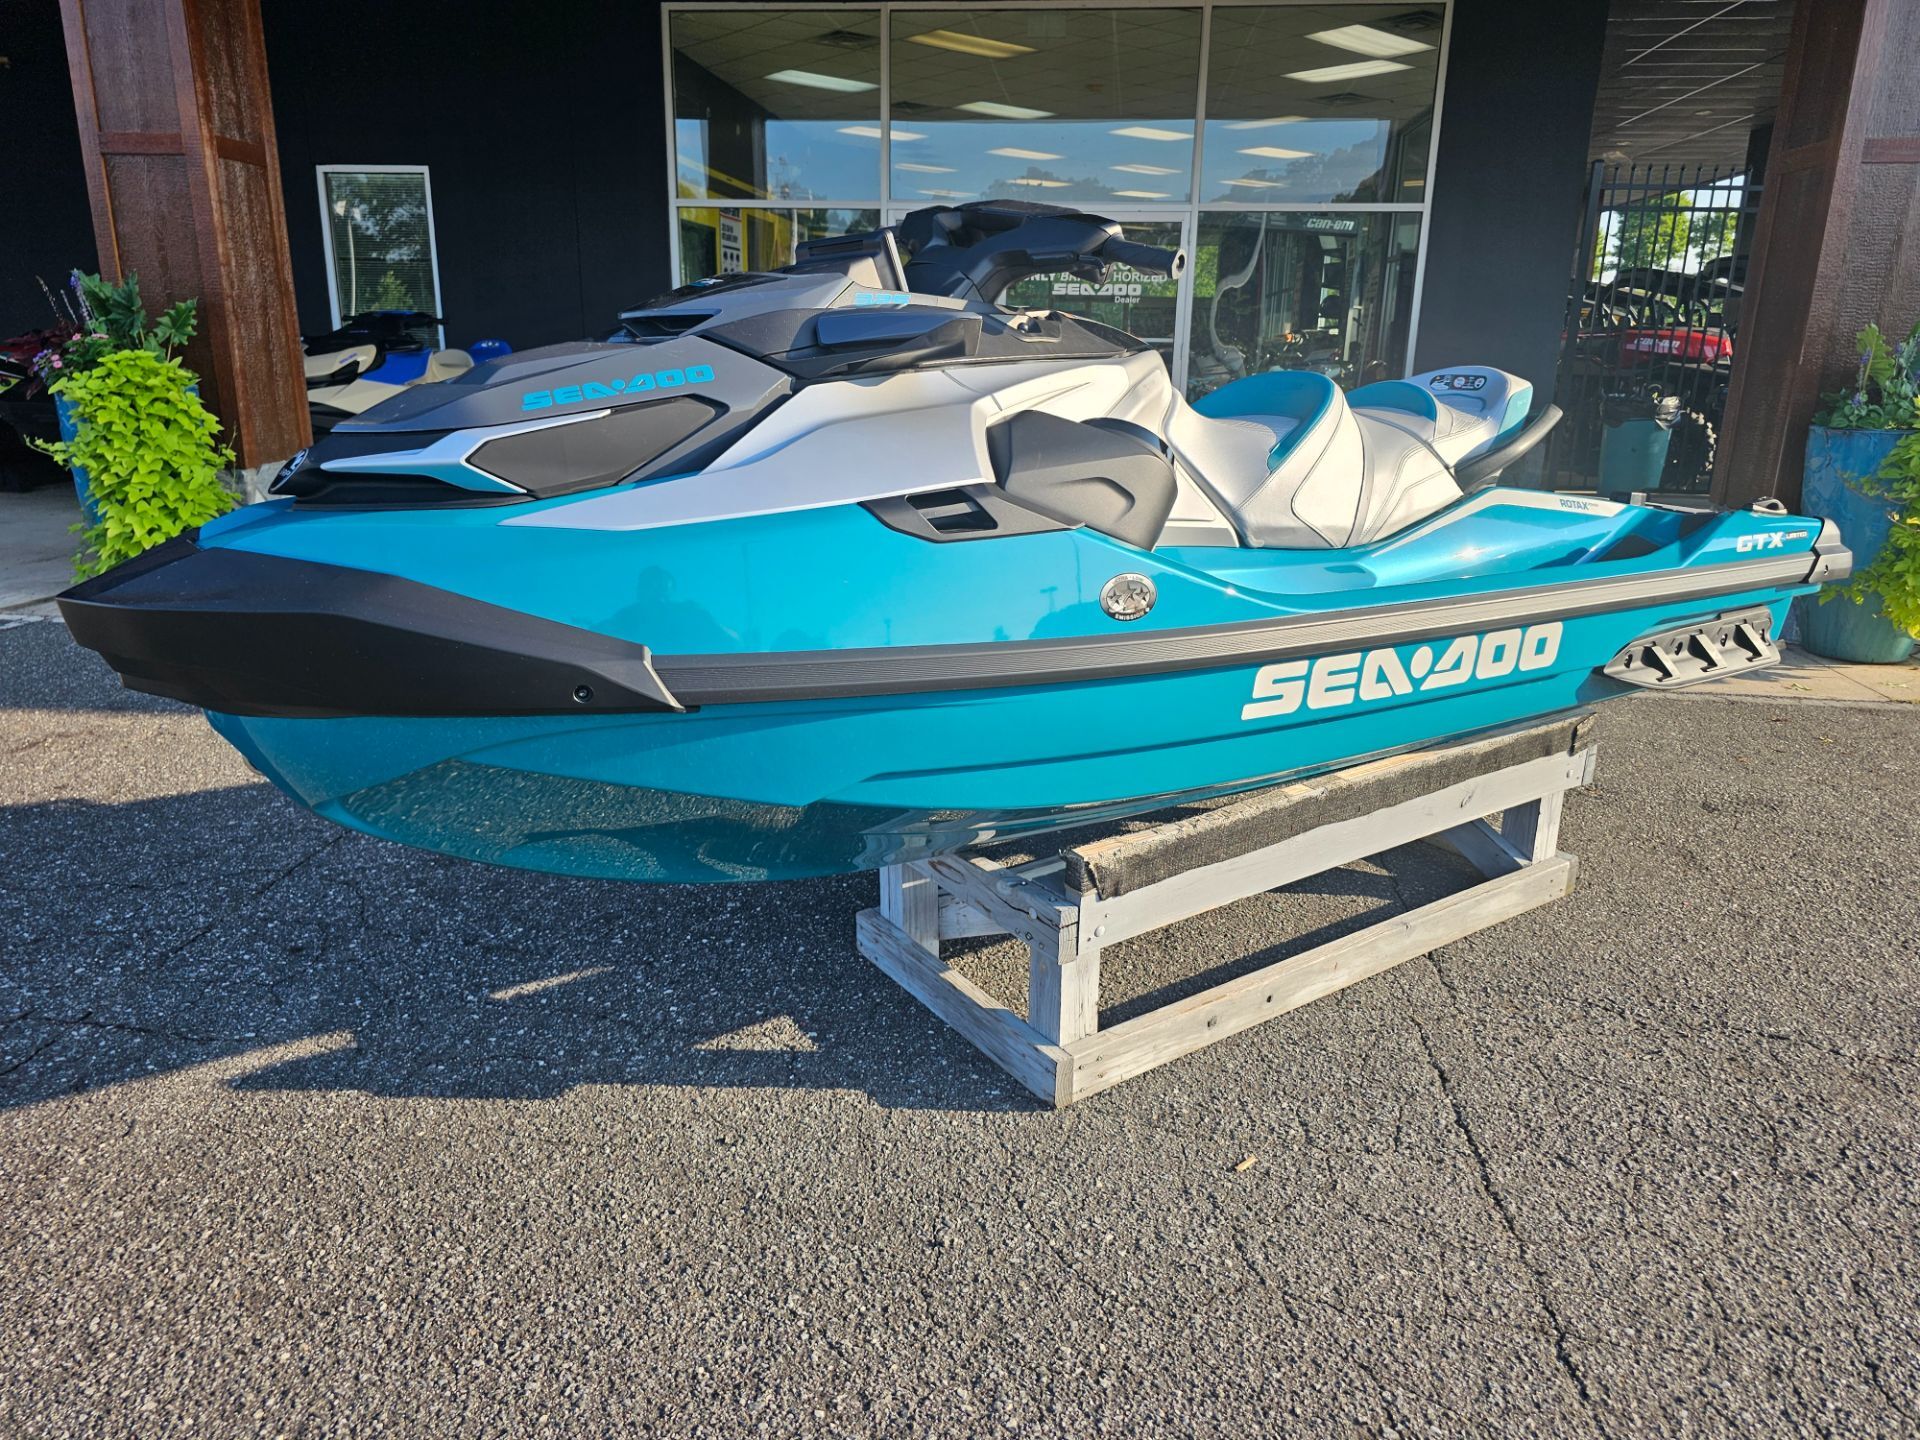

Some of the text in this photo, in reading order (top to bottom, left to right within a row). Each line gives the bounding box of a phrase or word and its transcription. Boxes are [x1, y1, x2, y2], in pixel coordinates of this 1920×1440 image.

[1307, 218, 1354, 231] can-am
[1023, 272, 1055, 281] NLY
[1114, 296, 1140, 304] Dealer
[1559, 498, 1590, 511] ROTAX
[1736, 531, 1784, 553] GTX
